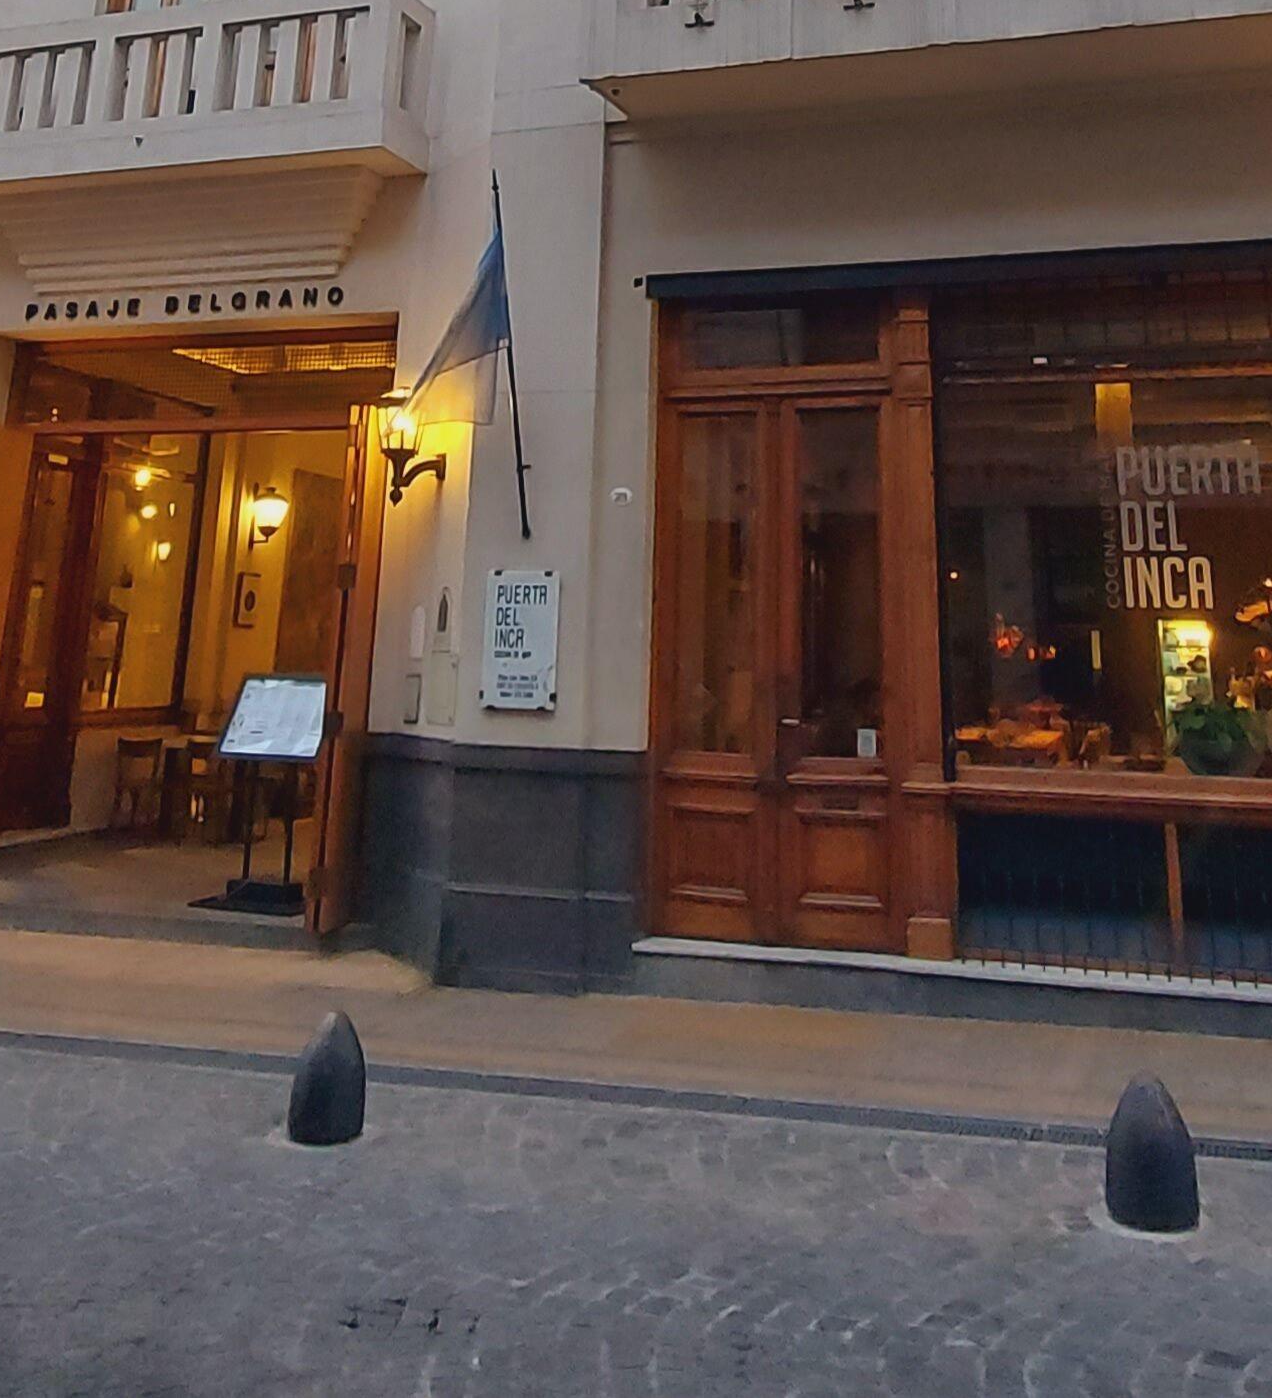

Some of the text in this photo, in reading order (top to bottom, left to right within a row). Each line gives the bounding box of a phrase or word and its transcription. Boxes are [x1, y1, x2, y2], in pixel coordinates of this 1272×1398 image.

[25, 286, 344, 321] PASAJE BELGRANO
[1116, 444, 1262, 496] PUERTA
[1119, 500, 1188, 551] DEL
[1103, 528, 1121, 610] COCINA
[1123, 556, 1214, 610] INCA
[496, 606, 520, 626] DEL
[497, 584, 548, 605] PUERTA
[494, 628, 524, 649] INCA
